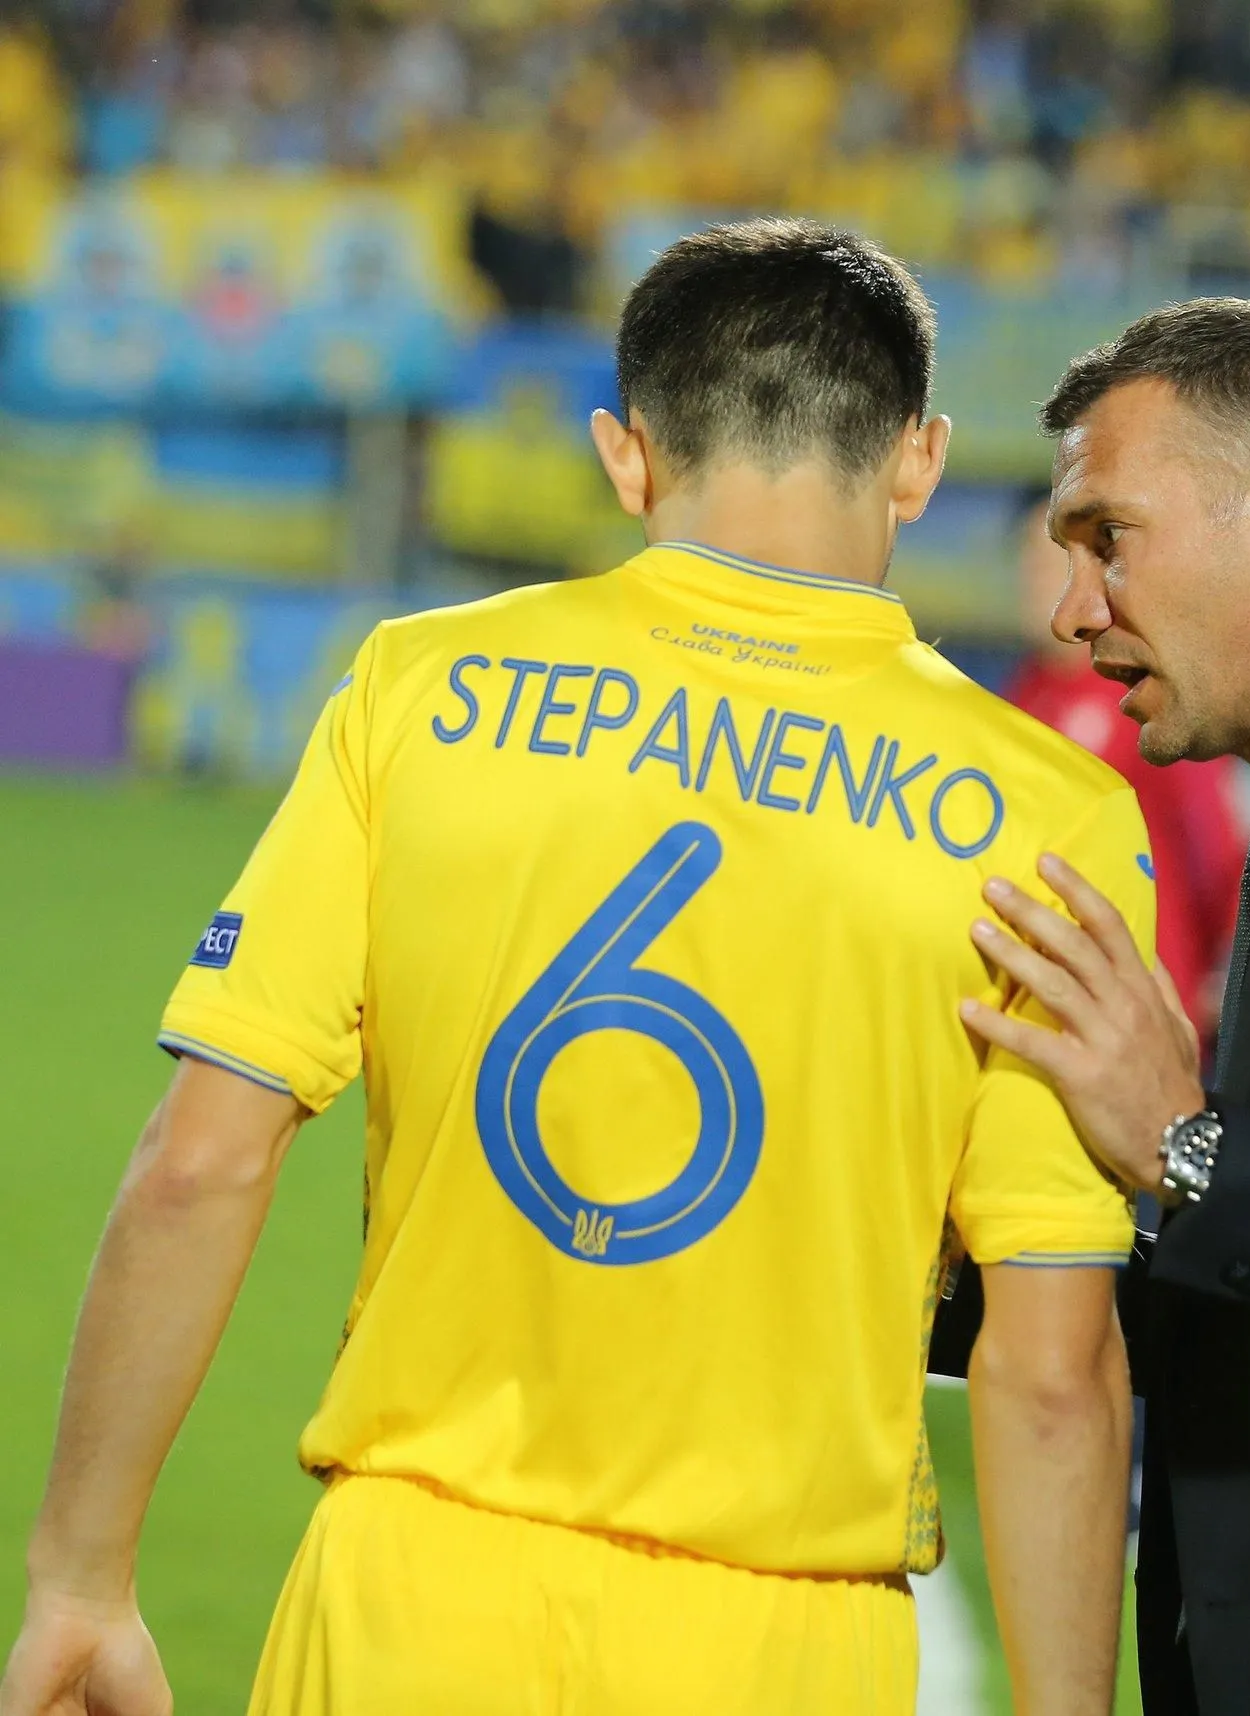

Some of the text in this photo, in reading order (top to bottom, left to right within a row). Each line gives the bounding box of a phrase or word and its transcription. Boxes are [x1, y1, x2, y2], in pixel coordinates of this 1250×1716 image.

[650, 627, 723, 656] Слава
[691, 623, 800, 654] UKRAINE
[433, 655, 1003, 858] STEPANENKO
[477, 822, 764, 1265] 6
